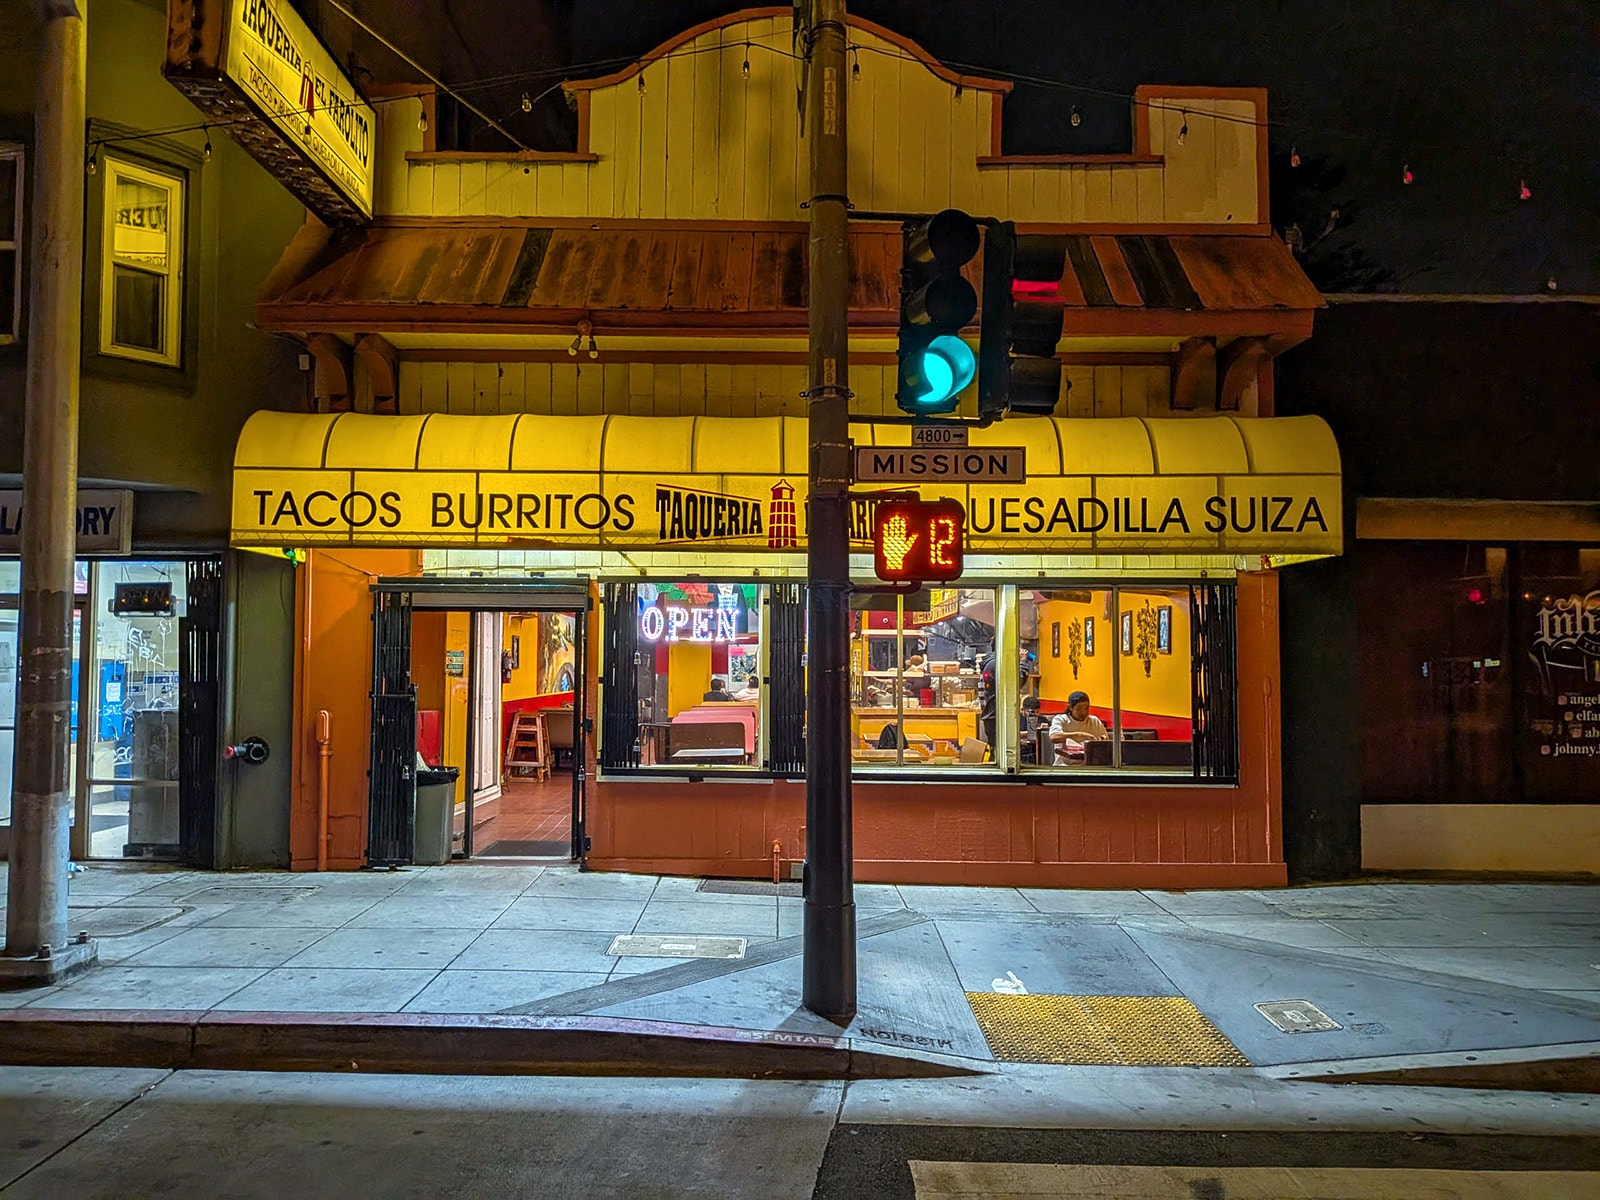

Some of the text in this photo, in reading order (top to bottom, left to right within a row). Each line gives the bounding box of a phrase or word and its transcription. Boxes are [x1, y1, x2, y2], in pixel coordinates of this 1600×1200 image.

[249, 66, 360, 194] TACOS BURRITO QUESADILLA SUIZA
[315, 76, 369, 168] EL FAROLITO
[916, 429, 951, 443] 4800
[873, 454, 1008, 475] MISSION
[253, 490, 402, 528] TACOS
[431, 492, 635, 530] BURRITOS
[656, 488, 763, 540] TAQUERIA
[963, 497, 1328, 533] UESADILLA SUIZA
[930, 519, 955, 564] 12
[641, 606, 740, 642] OPEN
[1533, 590, 1600, 647] Inh
